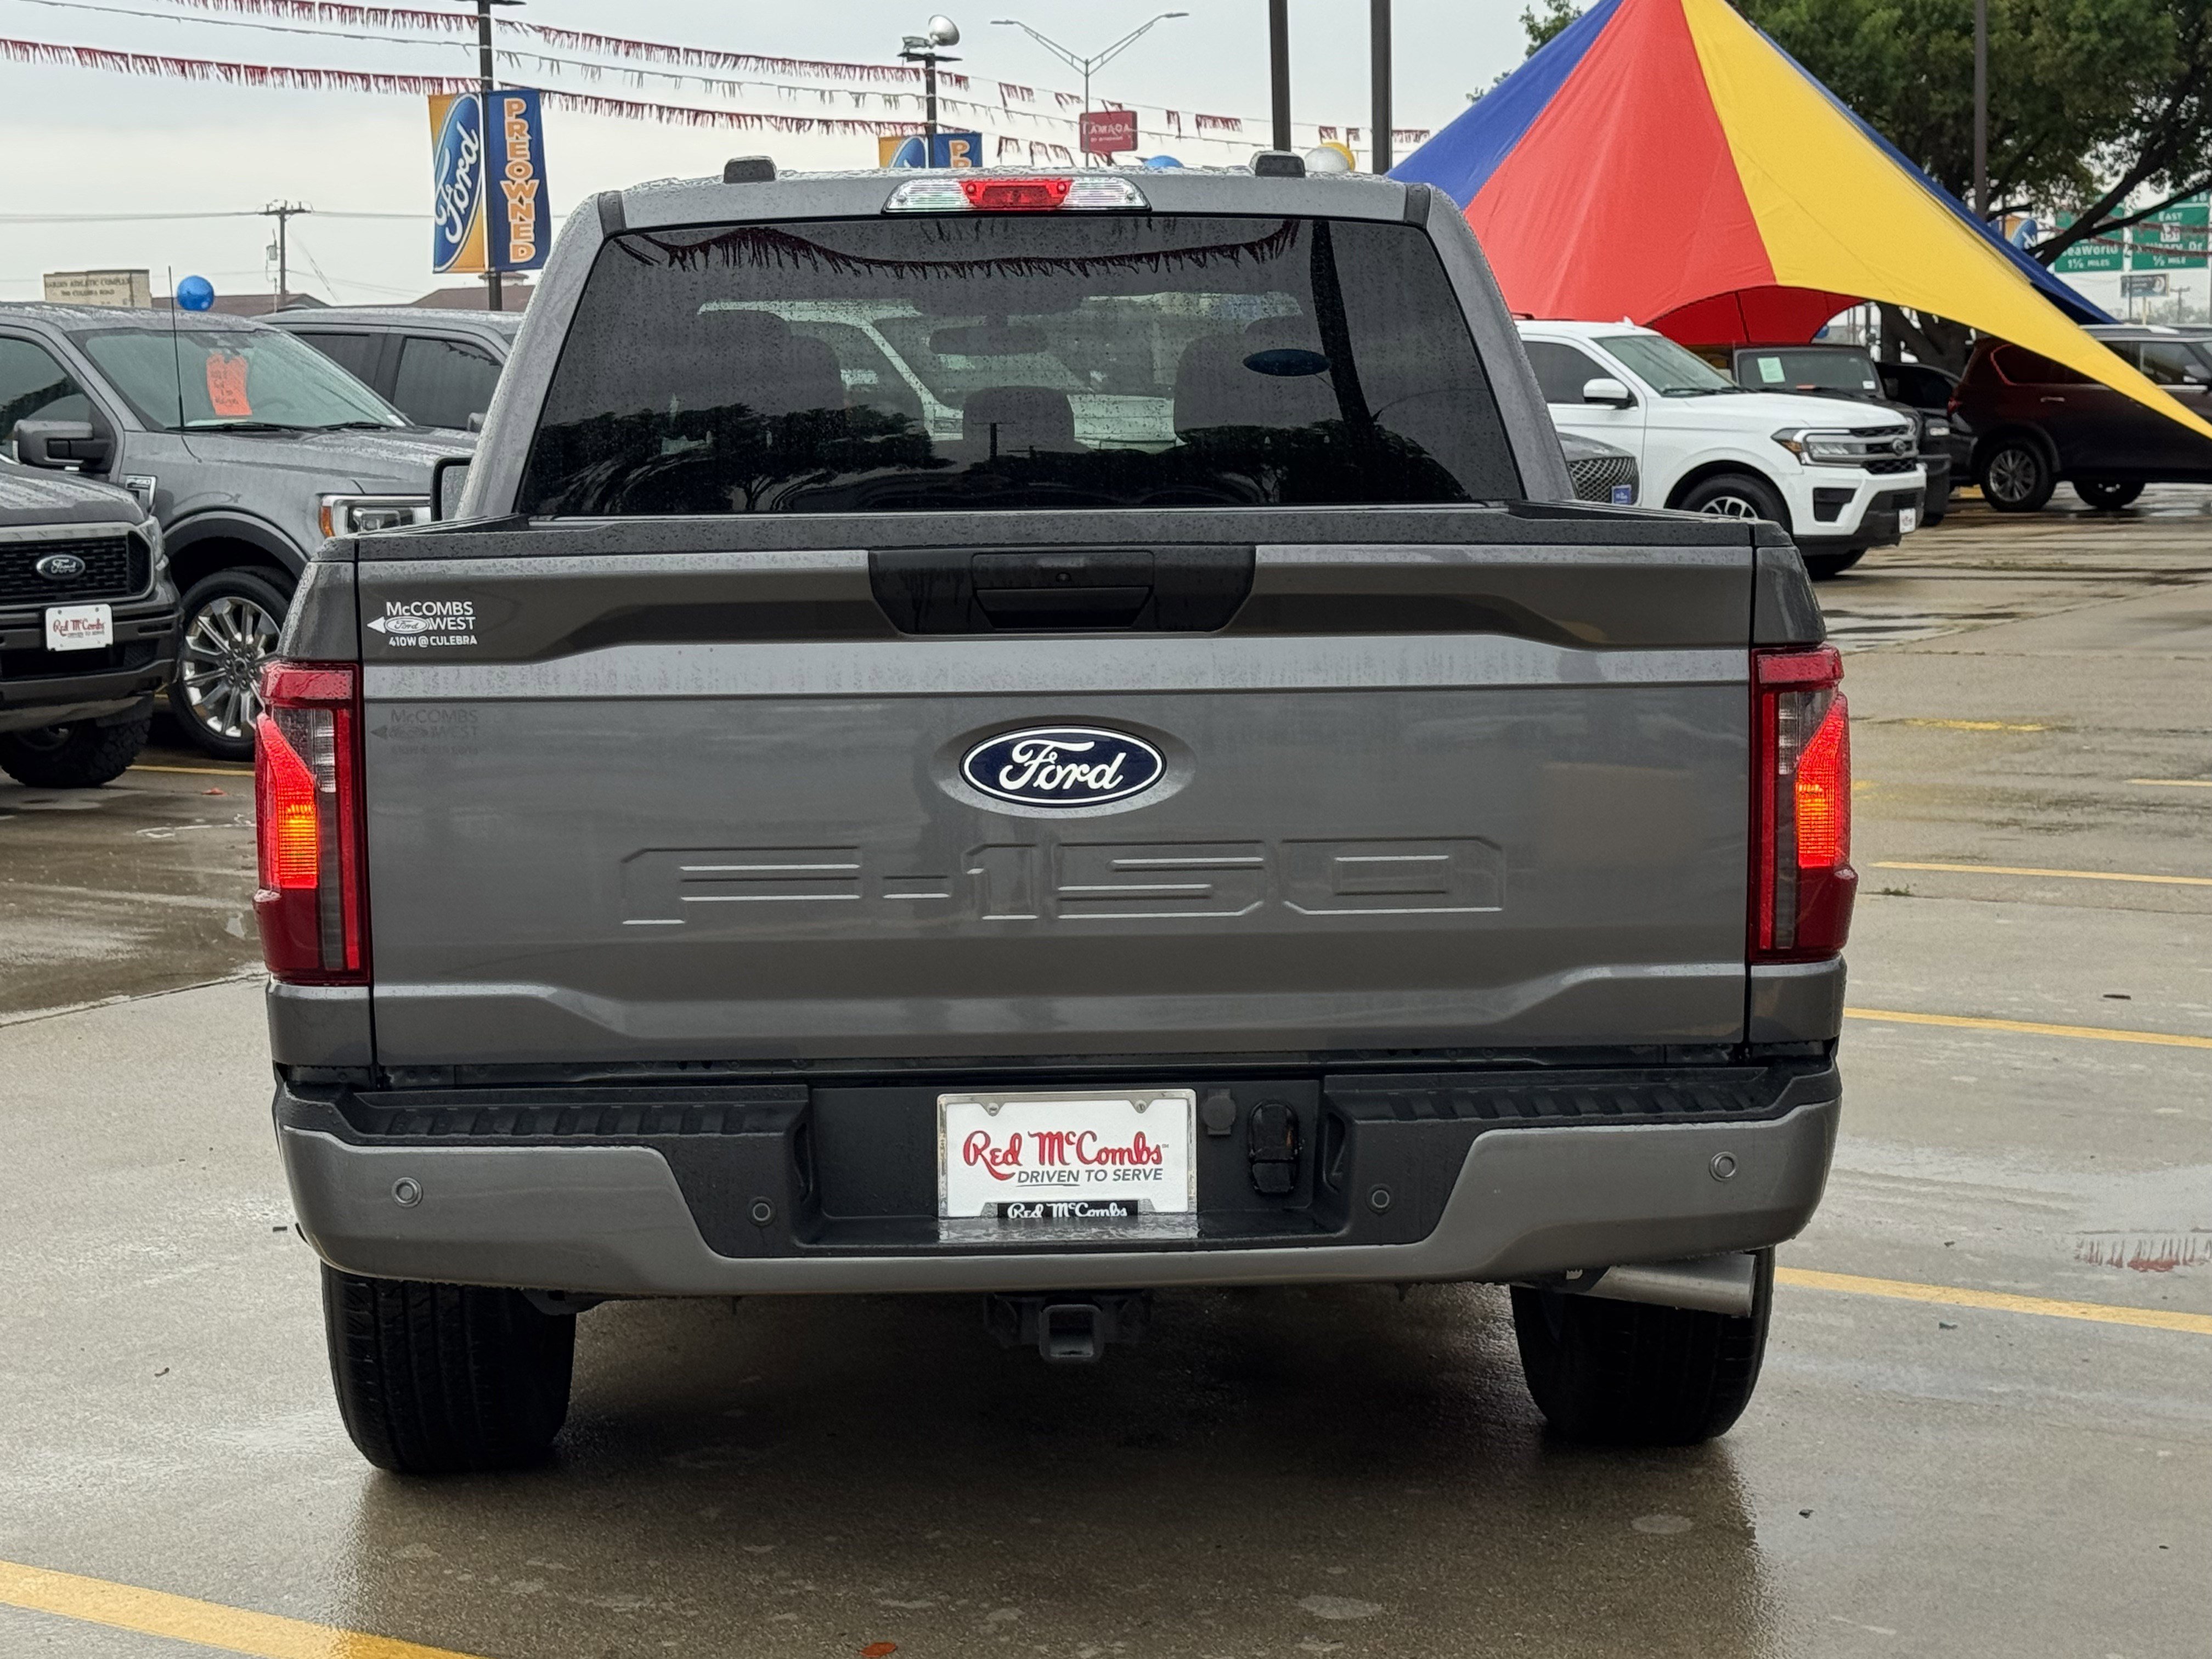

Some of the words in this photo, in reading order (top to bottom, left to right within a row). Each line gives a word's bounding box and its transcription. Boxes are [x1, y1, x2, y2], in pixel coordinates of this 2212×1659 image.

[435, 122, 480, 244] Ford
[500, 98, 539, 262] PREOWNED
[51, 559, 77, 574] Ford
[386, 601, 473, 616] McCOMBS
[394, 620, 419, 630] Ford
[430, 617, 476, 630] WEST
[999, 738, 1127, 791] Ford
[619, 836, 1505, 923] F-150
[963, 1130, 1023, 1181] Red
[1028, 1130, 1164, 1166] McCombs
[1017, 1169, 1080, 1184] DRIVEN
[1085, 1169, 1107, 1182] TO
[1113, 1168, 1164, 1181] SERVE
[1007, 1203, 1043, 1219] Red
[1048, 1202, 1128, 1218] McCombs
